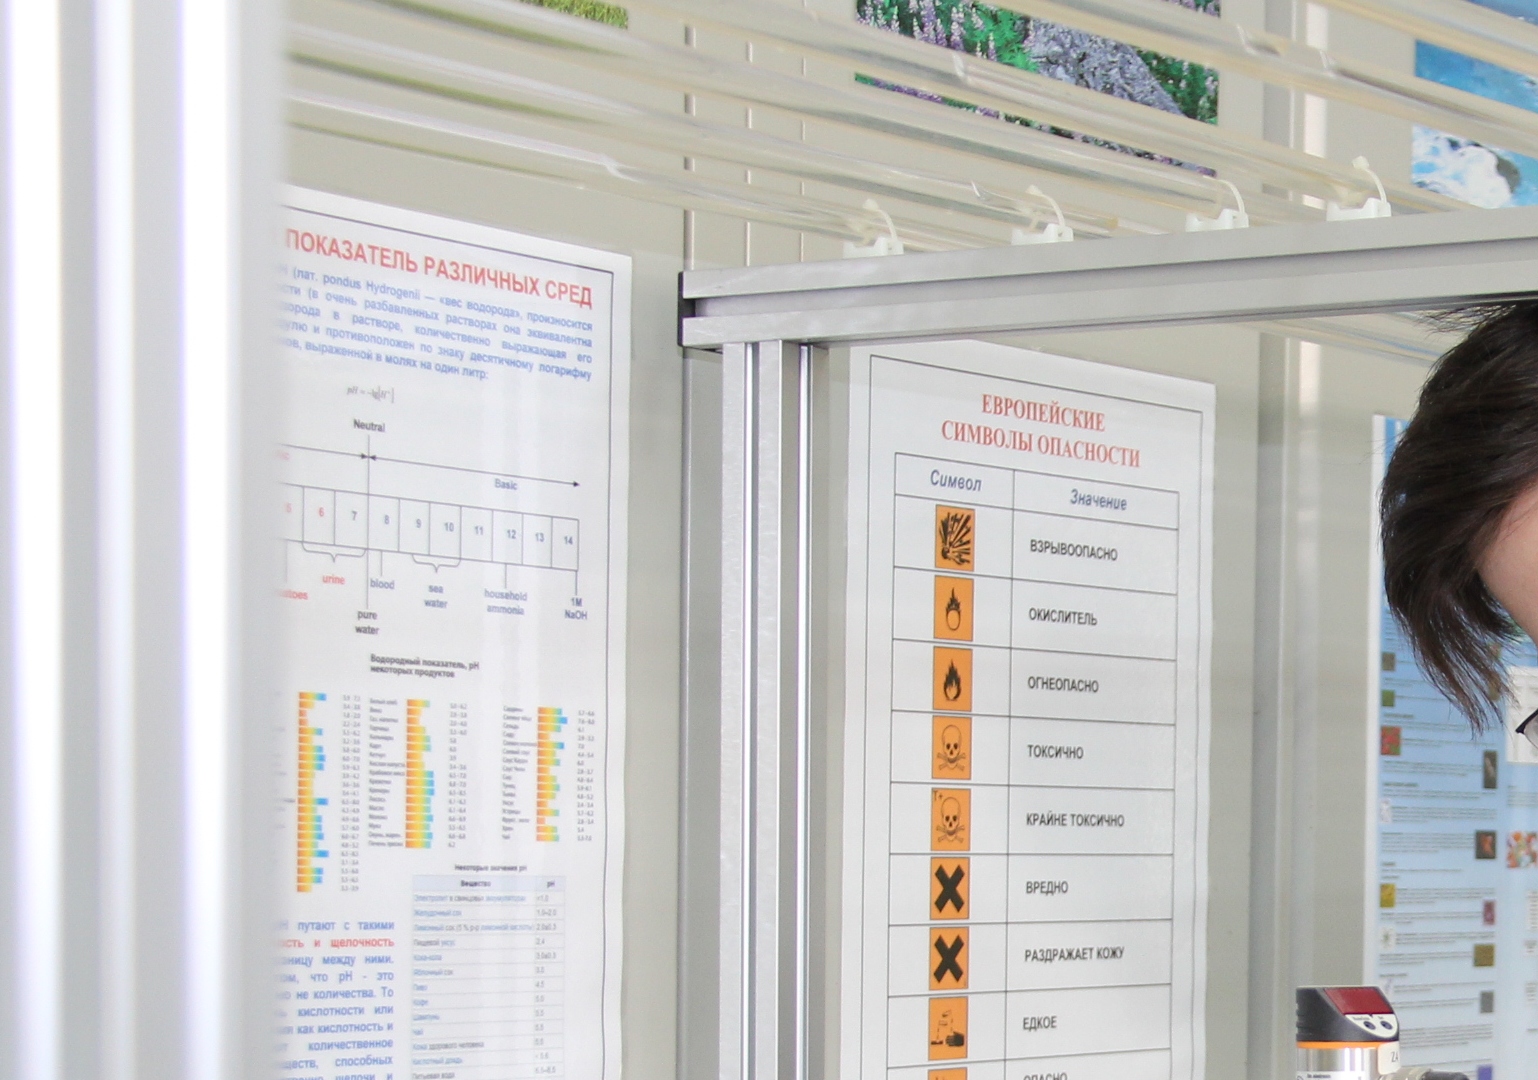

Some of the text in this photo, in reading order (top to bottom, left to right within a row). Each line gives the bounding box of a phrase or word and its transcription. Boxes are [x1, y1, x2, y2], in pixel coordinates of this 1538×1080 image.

[286, 228, 593, 310] ПОКАЗАТЕЛЬ РАЗЛИЧНЫХ СРЕД
[323, 273, 362, 290] pondus
[527, 311, 593, 331] произносится
[325, 291, 358, 306] очень
[364, 299, 440, 320] разбавленных
[445, 312, 498, 331] растворах
[503, 323, 521, 336] она
[527, 327, 593, 348] эквивалентна
[414, 325, 491, 347] количественно
[501, 340, 567, 360] выражающая
[577, 352, 593, 364] его
[313, 325, 320, 334] и
[325, 326, 415, 350] противоположен
[420, 343, 433, 353] по
[437, 346, 465, 361] знаку
[470, 351, 534, 372] десятичному
[538, 363, 592, 382] логарифму
[305, 340, 489, 381] выраженной в молях на один литр:
[982, 393, 1105, 432] ЕВРОПЕЙСКИЕ
[353, 418, 386, 433] Neutral
[941, 419, 1141, 468] СИМВОЛЫ ОПАСНОСТИ
[494, 478, 518, 490] Basic
[930, 468, 983, 493] Символ
[1069, 488, 1127, 511] Значение
[318, 506, 325, 517] 6
[350, 510, 358, 521] 7
[384, 515, 390, 525] 8
[415, 518, 422, 529] 9
[444, 521, 455, 533] 10
[474, 526, 484, 535] 11
[506, 529, 517, 540] 12
[534, 532, 545, 543] 13
[563, 535, 574, 546] 14
[1030, 538, 1118, 562] ВЗРЫВООПАСНО
[322, 574, 346, 586] urine
[370, 578, 395, 590] blood
[428, 585, 444, 594] sea
[484, 588, 528, 602] household
[424, 598, 448, 609] water
[571, 597, 583, 607] 1M
[357, 610, 378, 622] pure
[486, 605, 525, 616] ammonia
[564, 609, 588, 620] NaOH
[1028, 607, 1098, 627] ОКИСЛИТЕЛЬ
[355, 623, 380, 635] water
[1027, 675, 1099, 693] ОГНЕОПАСНО
[1027, 744, 1084, 760] ТОКСИЧНО
[1026, 809, 1125, 828] КРАЙНЕ ТОКСИЧНО
[1026, 880, 1069, 895] ВРЕДНО
[297, 920, 336, 933] путают
[343, 922, 350, 931] с
[357, 920, 395, 931] такими
[314, 939, 321, 948] и
[330, 938, 395, 949] щелочность
[322, 955, 356, 967] между
[364, 955, 394, 965] ними.
[1024, 946, 1125, 963] РАЗДРАЖАЕТ КОЖУ
[310, 972, 328, 982] что
[376, 971, 394, 981] это
[297, 991, 308, 1000] не
[313, 988, 376, 999] количества.
[381, 986, 394, 997] То
[298, 1006, 365, 1017] кислотности
[374, 1005, 394, 1015] или
[297, 1025, 314, 1035] как
[318, 1022, 384, 1034] кислотность
[387, 1022, 394, 1031] и
[1022, 1015, 1057, 1032] ЕДКОЕ
[308, 1038, 393, 1051] количественное
[335, 1054, 393, 1067] способных
[387, 1072, 393, 1080] и
